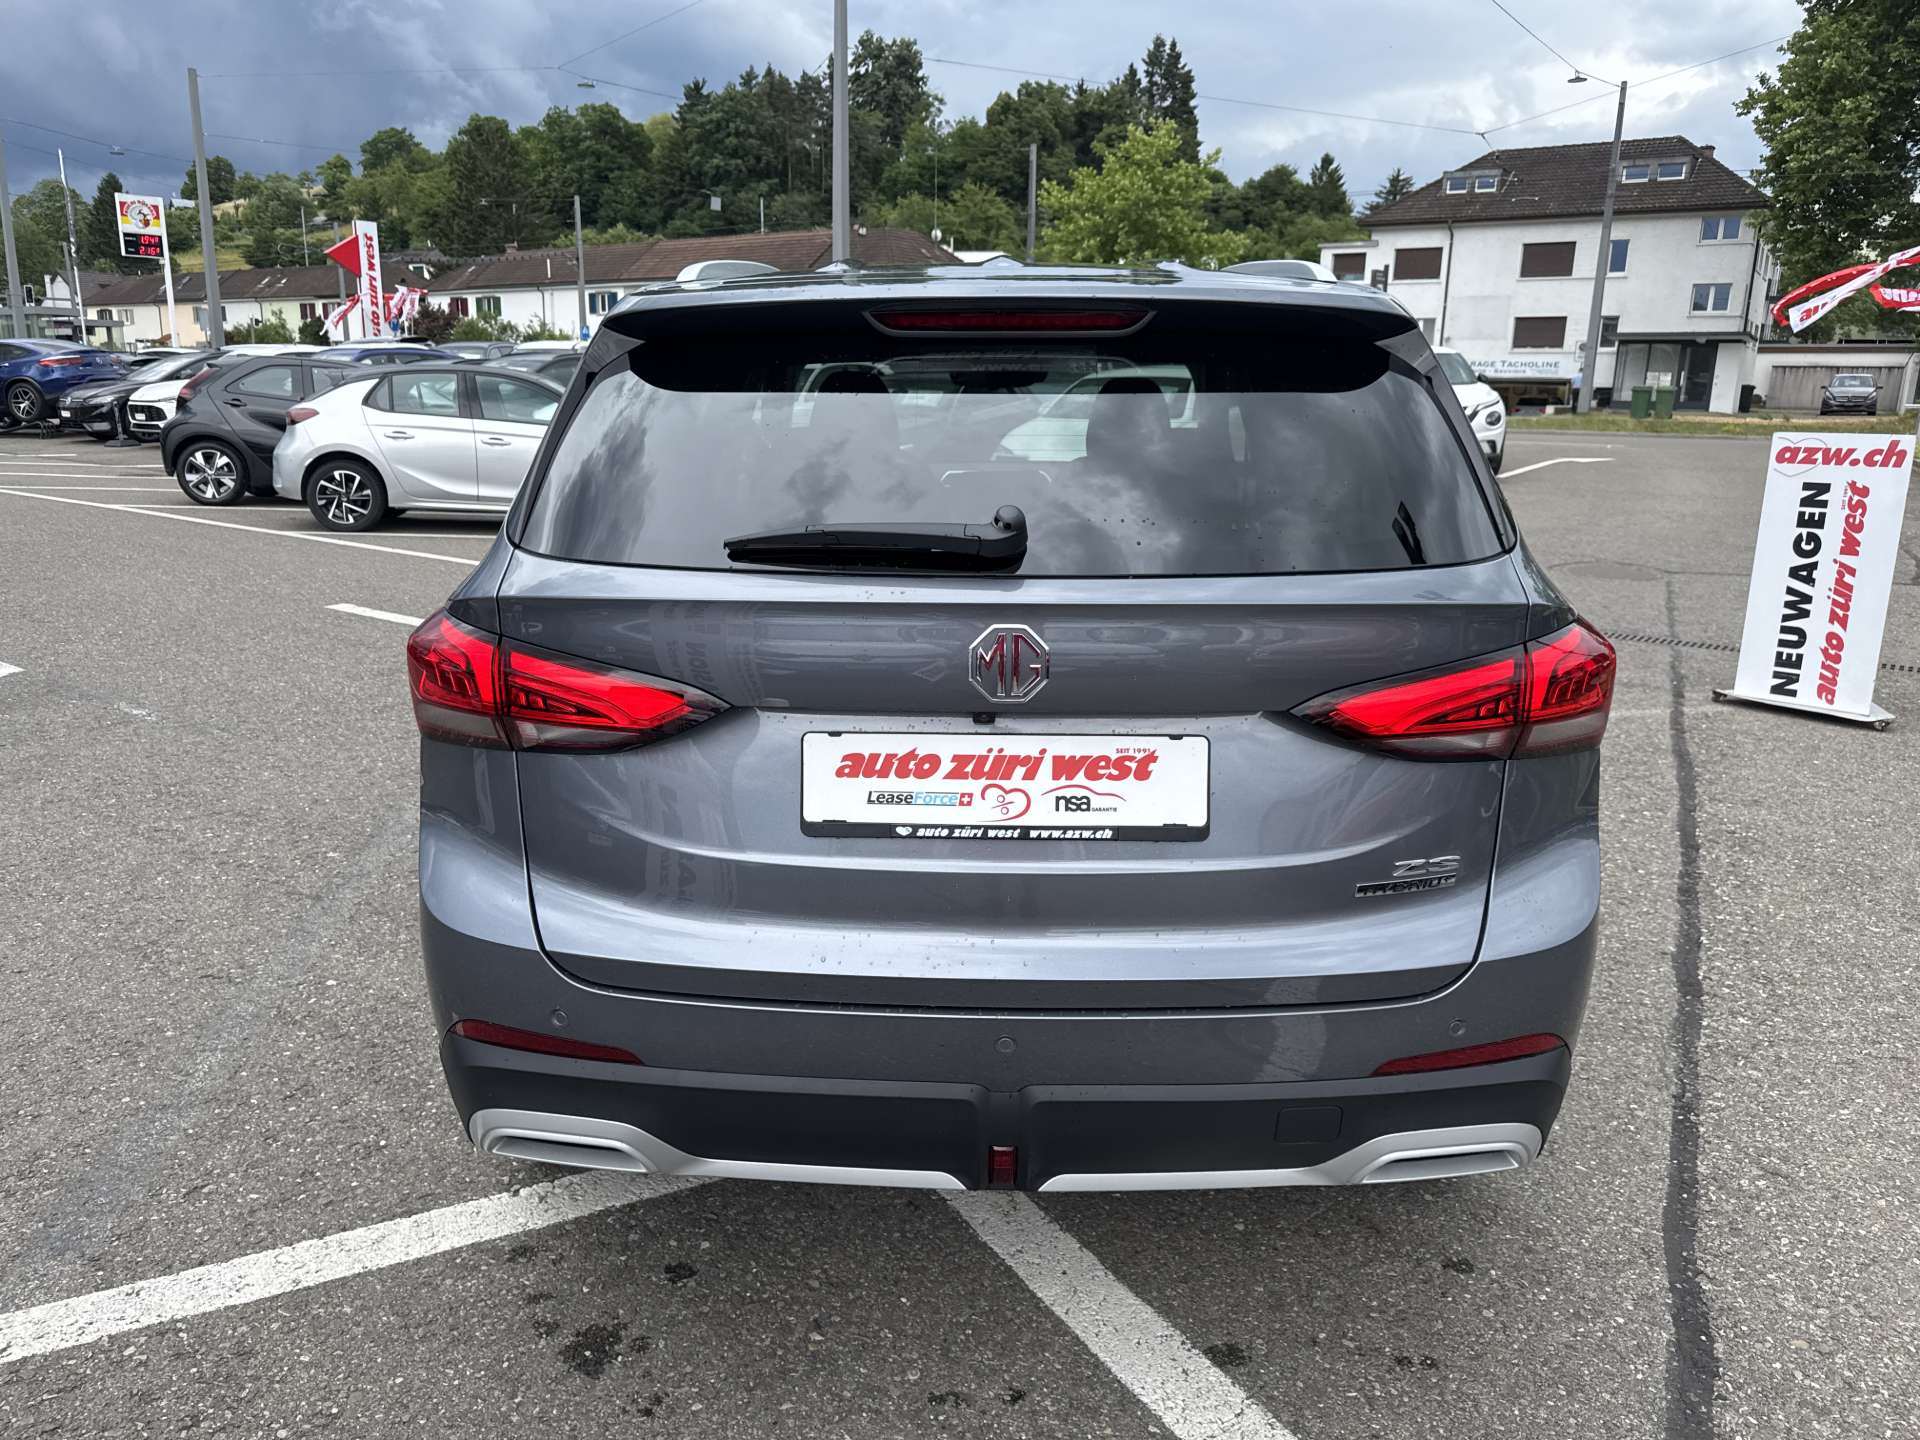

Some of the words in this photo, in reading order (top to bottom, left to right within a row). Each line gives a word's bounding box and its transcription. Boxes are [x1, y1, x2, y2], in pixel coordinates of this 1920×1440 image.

[1501, 360, 1560, 369] TACHOLINE
[1775, 439, 1908, 468] azw.ch
[1840, 480, 1870, 557] west
[1770, 482, 1831, 698] NEUWAGEN
[1827, 558, 1857, 633] züri
[976, 632, 1042, 697] MG
[1817, 631, 1845, 705] auto
[835, 747, 942, 780] auto
[942, 747, 1048, 781] züri
[1052, 749, 1160, 781] west
[867, 790, 959, 806] LeaseForce
[1055, 795, 1091, 813] nsa
[916, 826, 950, 838] auto
[952, 826, 985, 838] züri
[987, 828, 1021, 839] west
[1029, 828, 1113, 840] www.azw.ch
[1392, 855, 1461, 877] ZS
